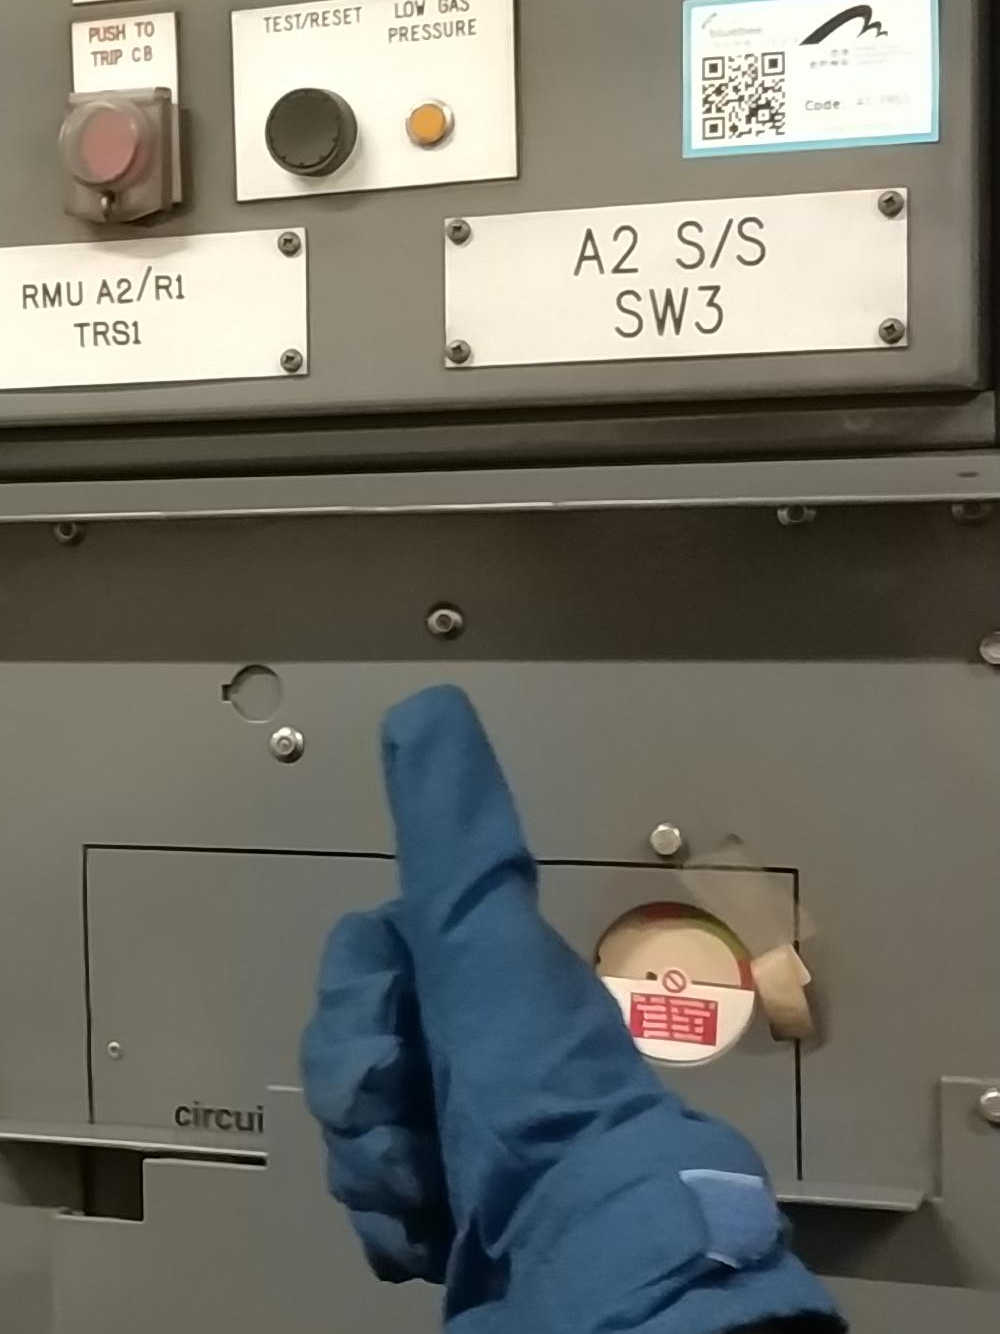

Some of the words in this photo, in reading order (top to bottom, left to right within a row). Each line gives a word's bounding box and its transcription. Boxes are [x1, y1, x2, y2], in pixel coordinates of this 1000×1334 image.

[88, 23, 126, 44] PUSH
[134, 21, 156, 38] TO
[263, 6, 363, 34] TEST/RESET
[387, 18, 478, 45] PRESSURE
[91, 48, 123, 68] TRIP
[131, 45, 153, 63] CB
[573, 224, 640, 276] A2
[675, 216, 768, 271] S/S
[21, 280, 85, 310] RMU
[96, 265, 187, 306] A2/R1
[613, 284, 725, 339] SW3
[73, 319, 143, 348] TRS1
